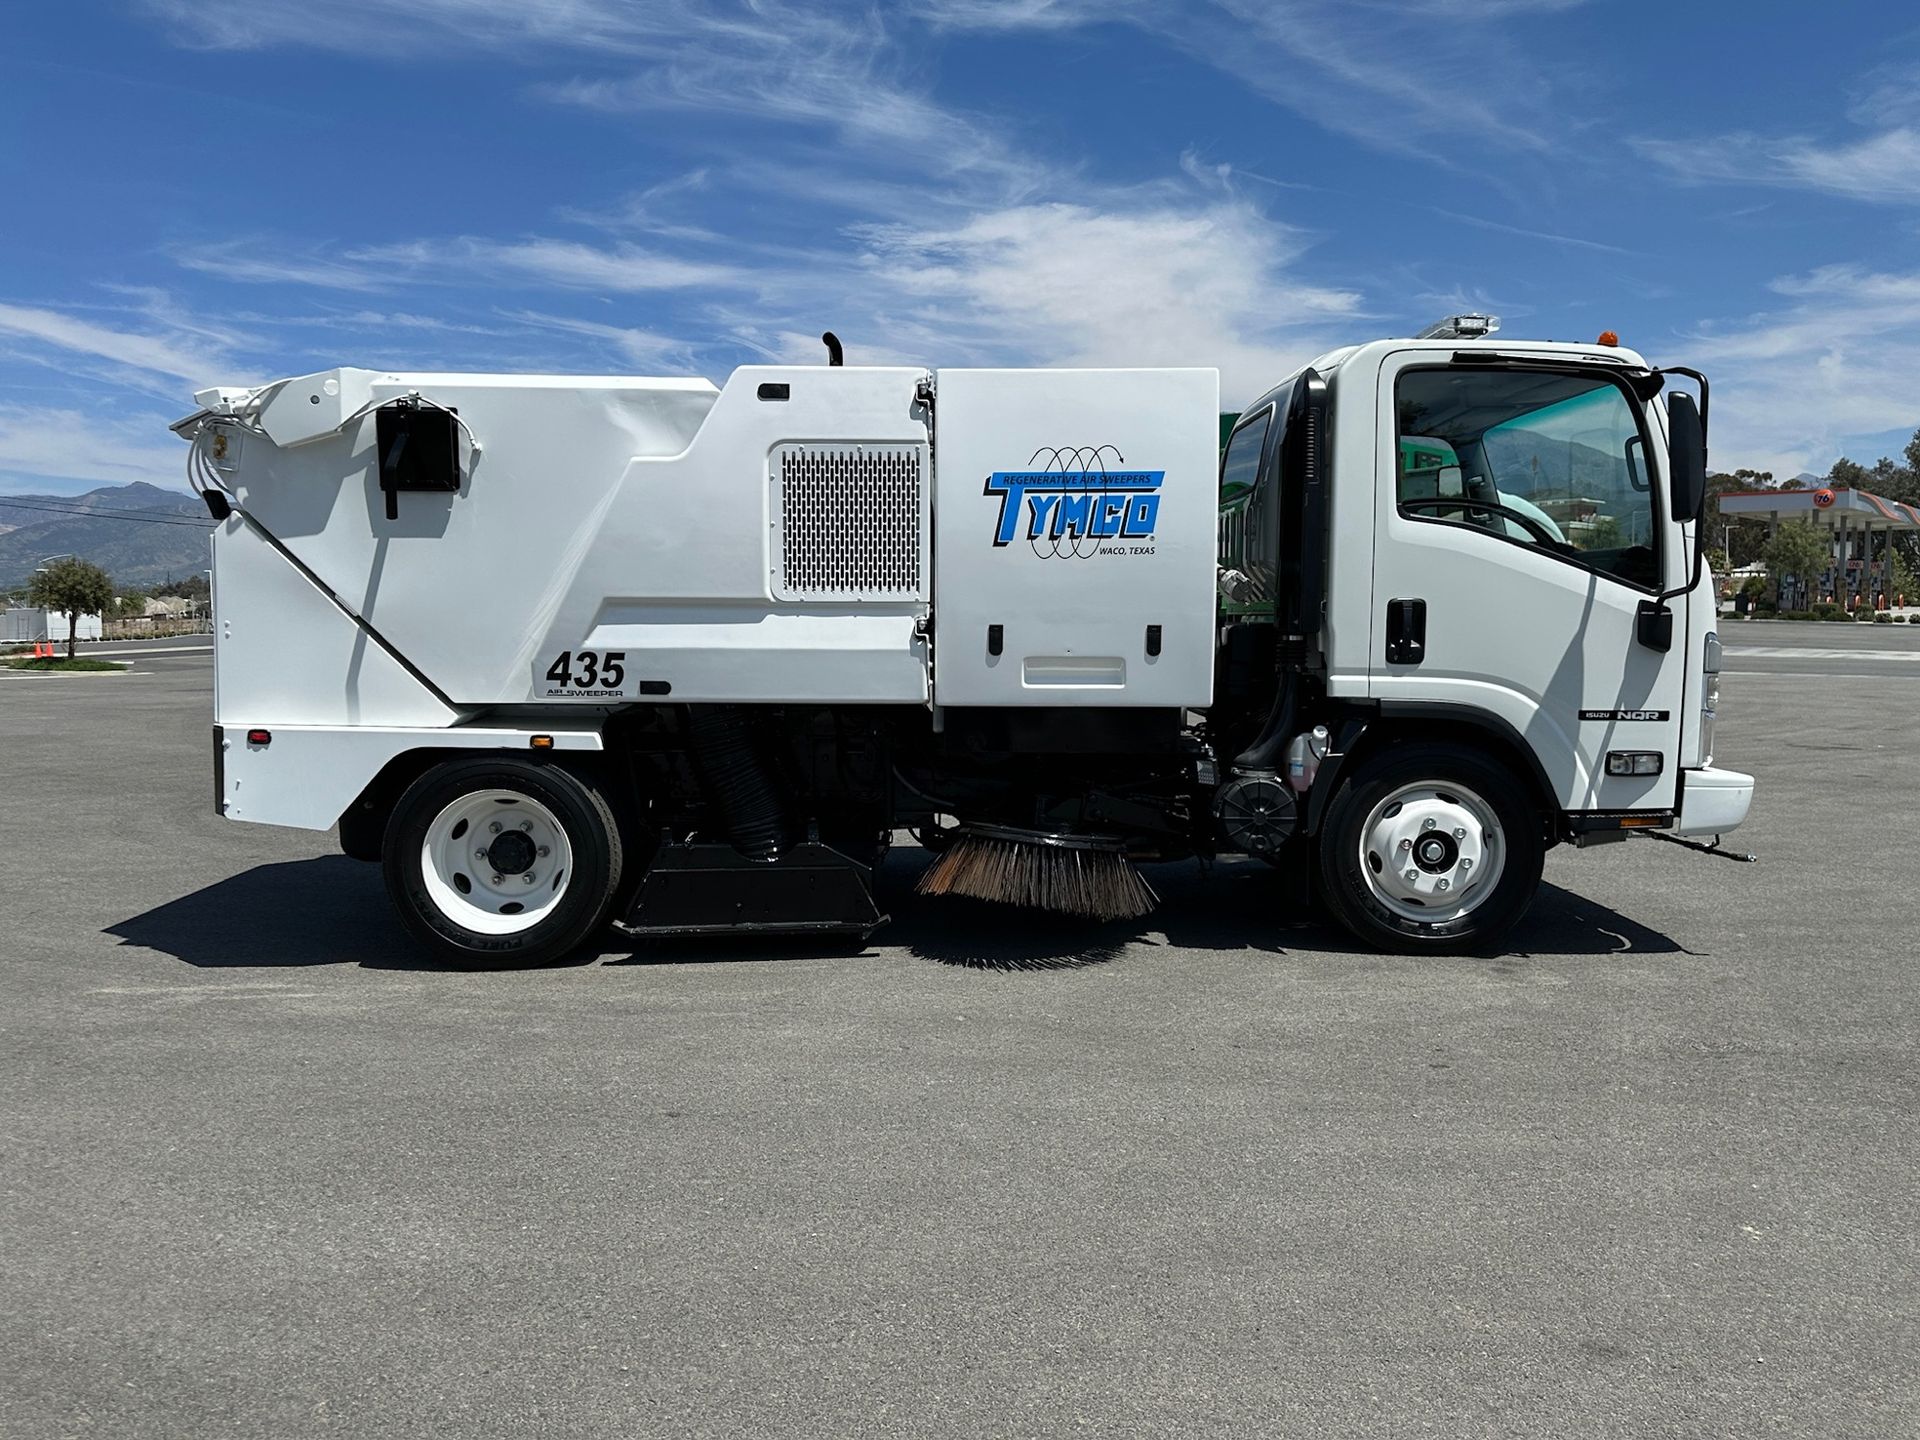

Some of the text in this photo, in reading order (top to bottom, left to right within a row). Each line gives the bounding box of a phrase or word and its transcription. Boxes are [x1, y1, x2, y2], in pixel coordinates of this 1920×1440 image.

[1003, 474, 1152, 485] REGENERATIVE AIR SWEEPERS
[1817, 494, 1830, 504] 76
[983, 471, 1166, 547] TYMCO
[1099, 547, 1156, 556] WACO, TEXAS
[546, 651, 626, 688] 435
[1616, 711, 1660, 721] NQR
